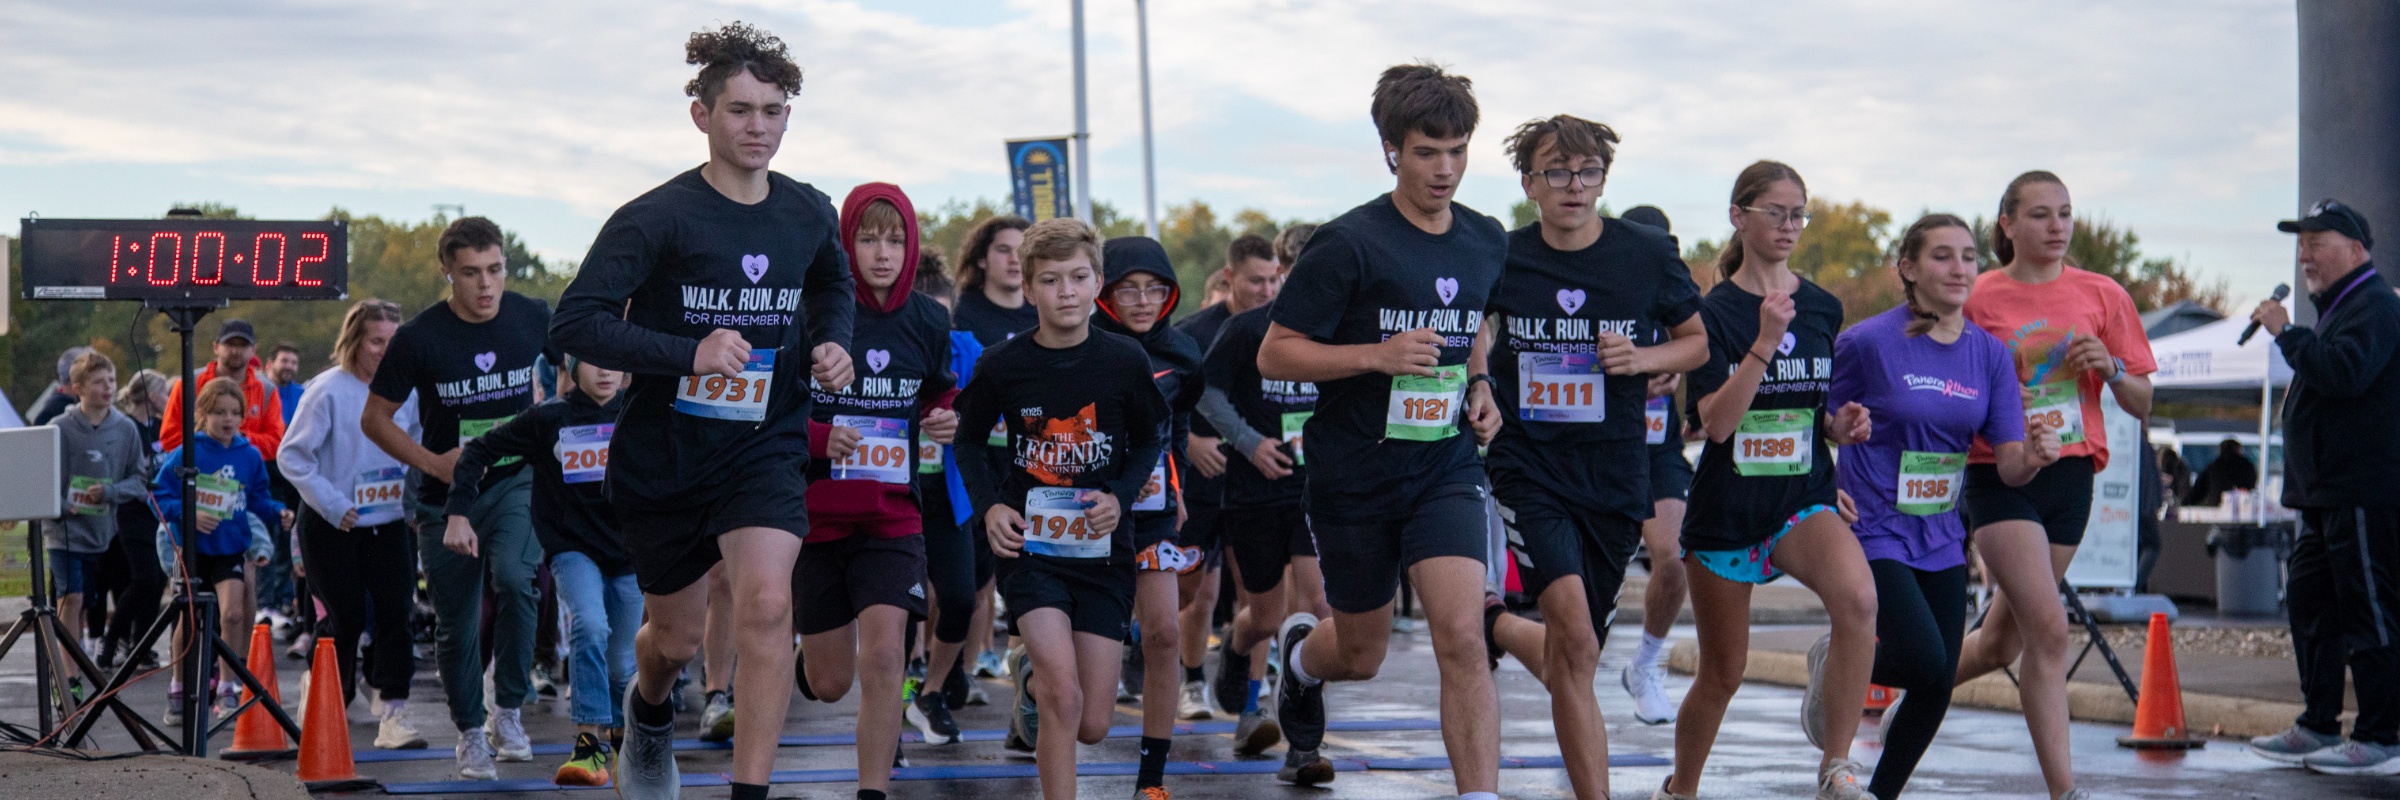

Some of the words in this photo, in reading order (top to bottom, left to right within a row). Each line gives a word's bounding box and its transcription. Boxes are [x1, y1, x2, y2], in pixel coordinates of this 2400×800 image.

[681, 285, 733, 311] WALK.
[738, 288, 773, 312] RUN.
[684, 311, 710, 325] FOR
[713, 314, 780, 326] REMEMBER
[1428, 308, 1463, 332] RUN.
[1506, 315, 1551, 340] WALK.
[1556, 318, 1594, 341] RUN.
[1776, 358, 1810, 382] RUN.
[435, 378, 476, 399] WALK.
[476, 372, 506, 393] RUN.
[686, 376, 767, 404] 1931
[862, 376, 895, 398] RUN.
[1527, 381, 1593, 406] 2111
[1756, 381, 1816, 395] REMEMBER
[462, 388, 513, 406] REMEMBER
[810, 391, 835, 405] FOR
[838, 397, 902, 410] REMEMBER
[1020, 407, 1043, 417] 2025
[1403, 397, 1449, 421] 1121
[1053, 432, 1074, 442] THE
[1016, 434, 1113, 466] LEGENDS
[1014, 457, 1039, 469] CROSS
[1042, 465, 1086, 473] COUNTRY
[357, 484, 401, 505] 1944
[1906, 479, 1950, 499] 1135
